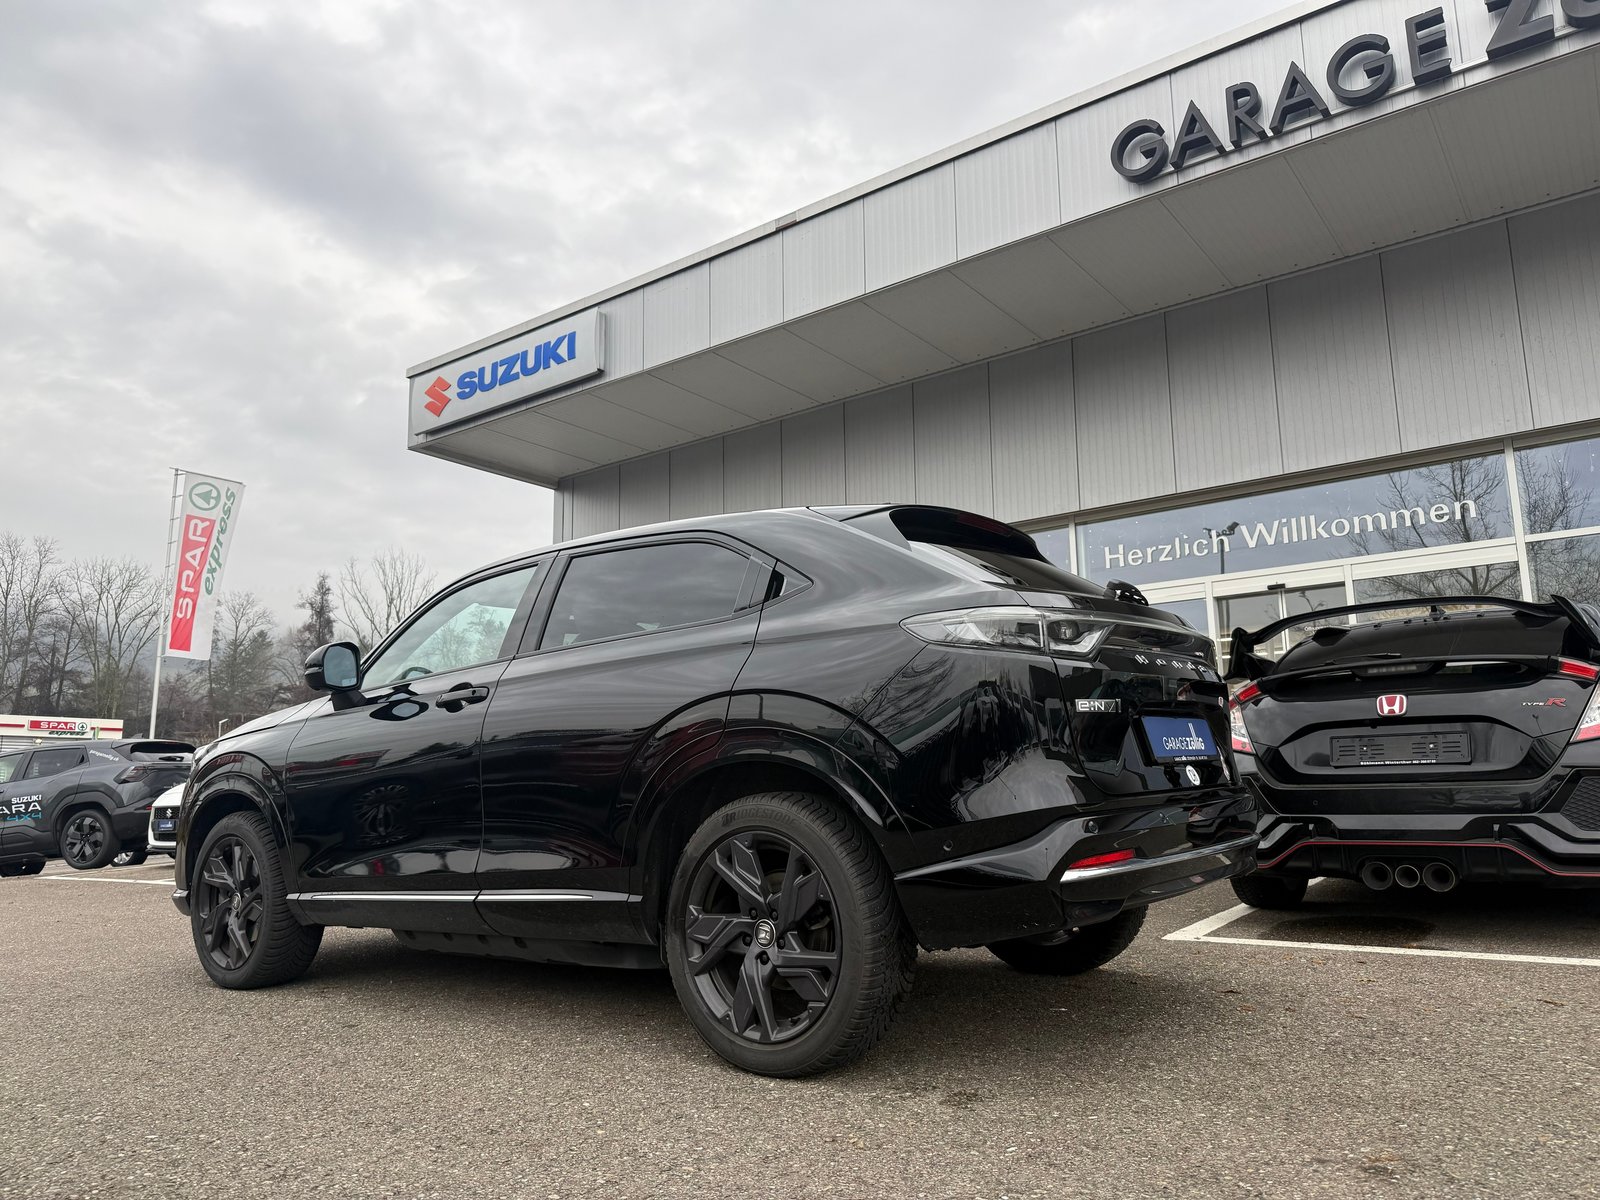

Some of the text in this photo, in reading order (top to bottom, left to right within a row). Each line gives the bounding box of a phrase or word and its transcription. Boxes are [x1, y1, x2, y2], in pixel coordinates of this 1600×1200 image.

[1111, 6, 1452, 184] GARAGE
[457, 331, 577, 400] SUZUKI
[177, 518, 210, 620] SPAR
[204, 487, 236, 596] express
[1104, 500, 1478, 569] Herzlich Willkommen
[40, 721, 76, 730] SPAR
[11, 794, 42, 804] SUZUKI
